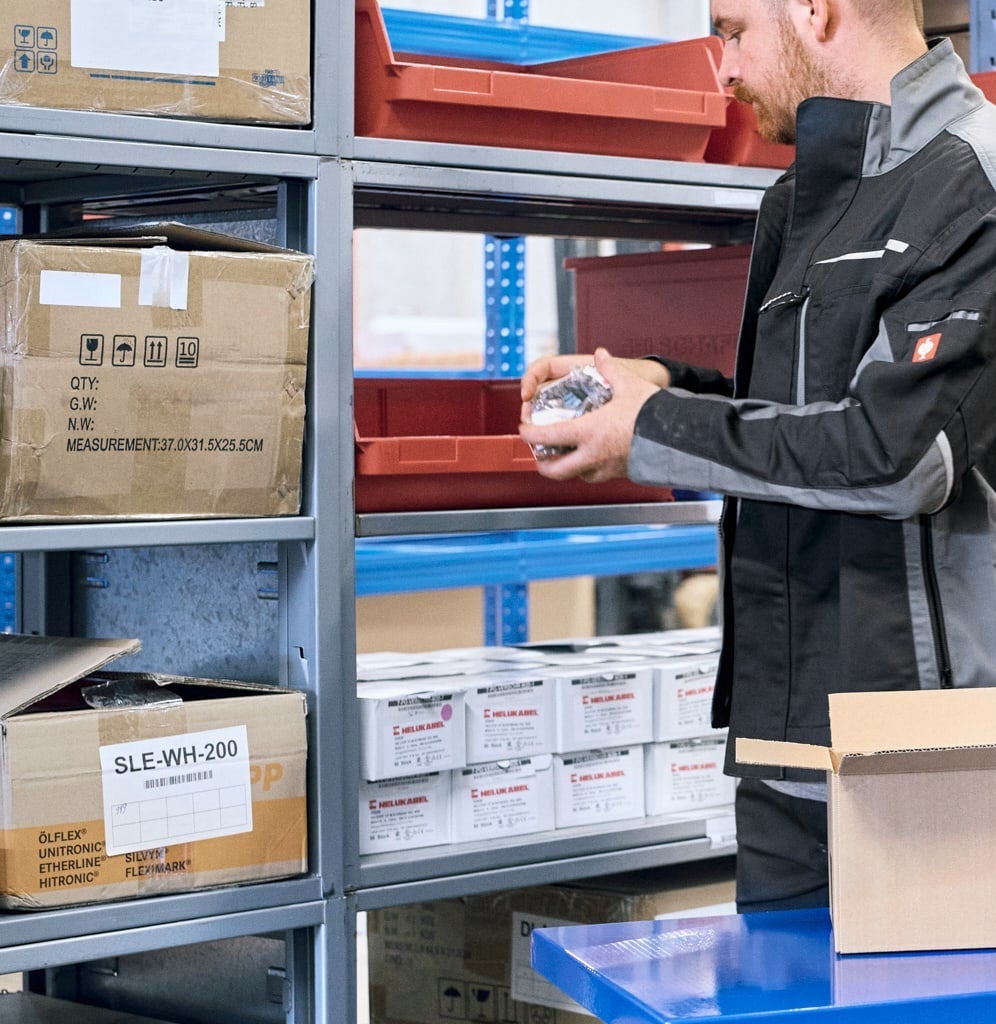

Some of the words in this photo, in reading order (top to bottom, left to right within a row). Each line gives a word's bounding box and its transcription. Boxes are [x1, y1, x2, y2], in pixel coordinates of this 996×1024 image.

[71, 376, 99, 391] QTY:
[69, 397, 97, 411] G.W:
[68, 417, 94, 431] N.W:
[114, 739, 238, 775] SLE-WH-200
